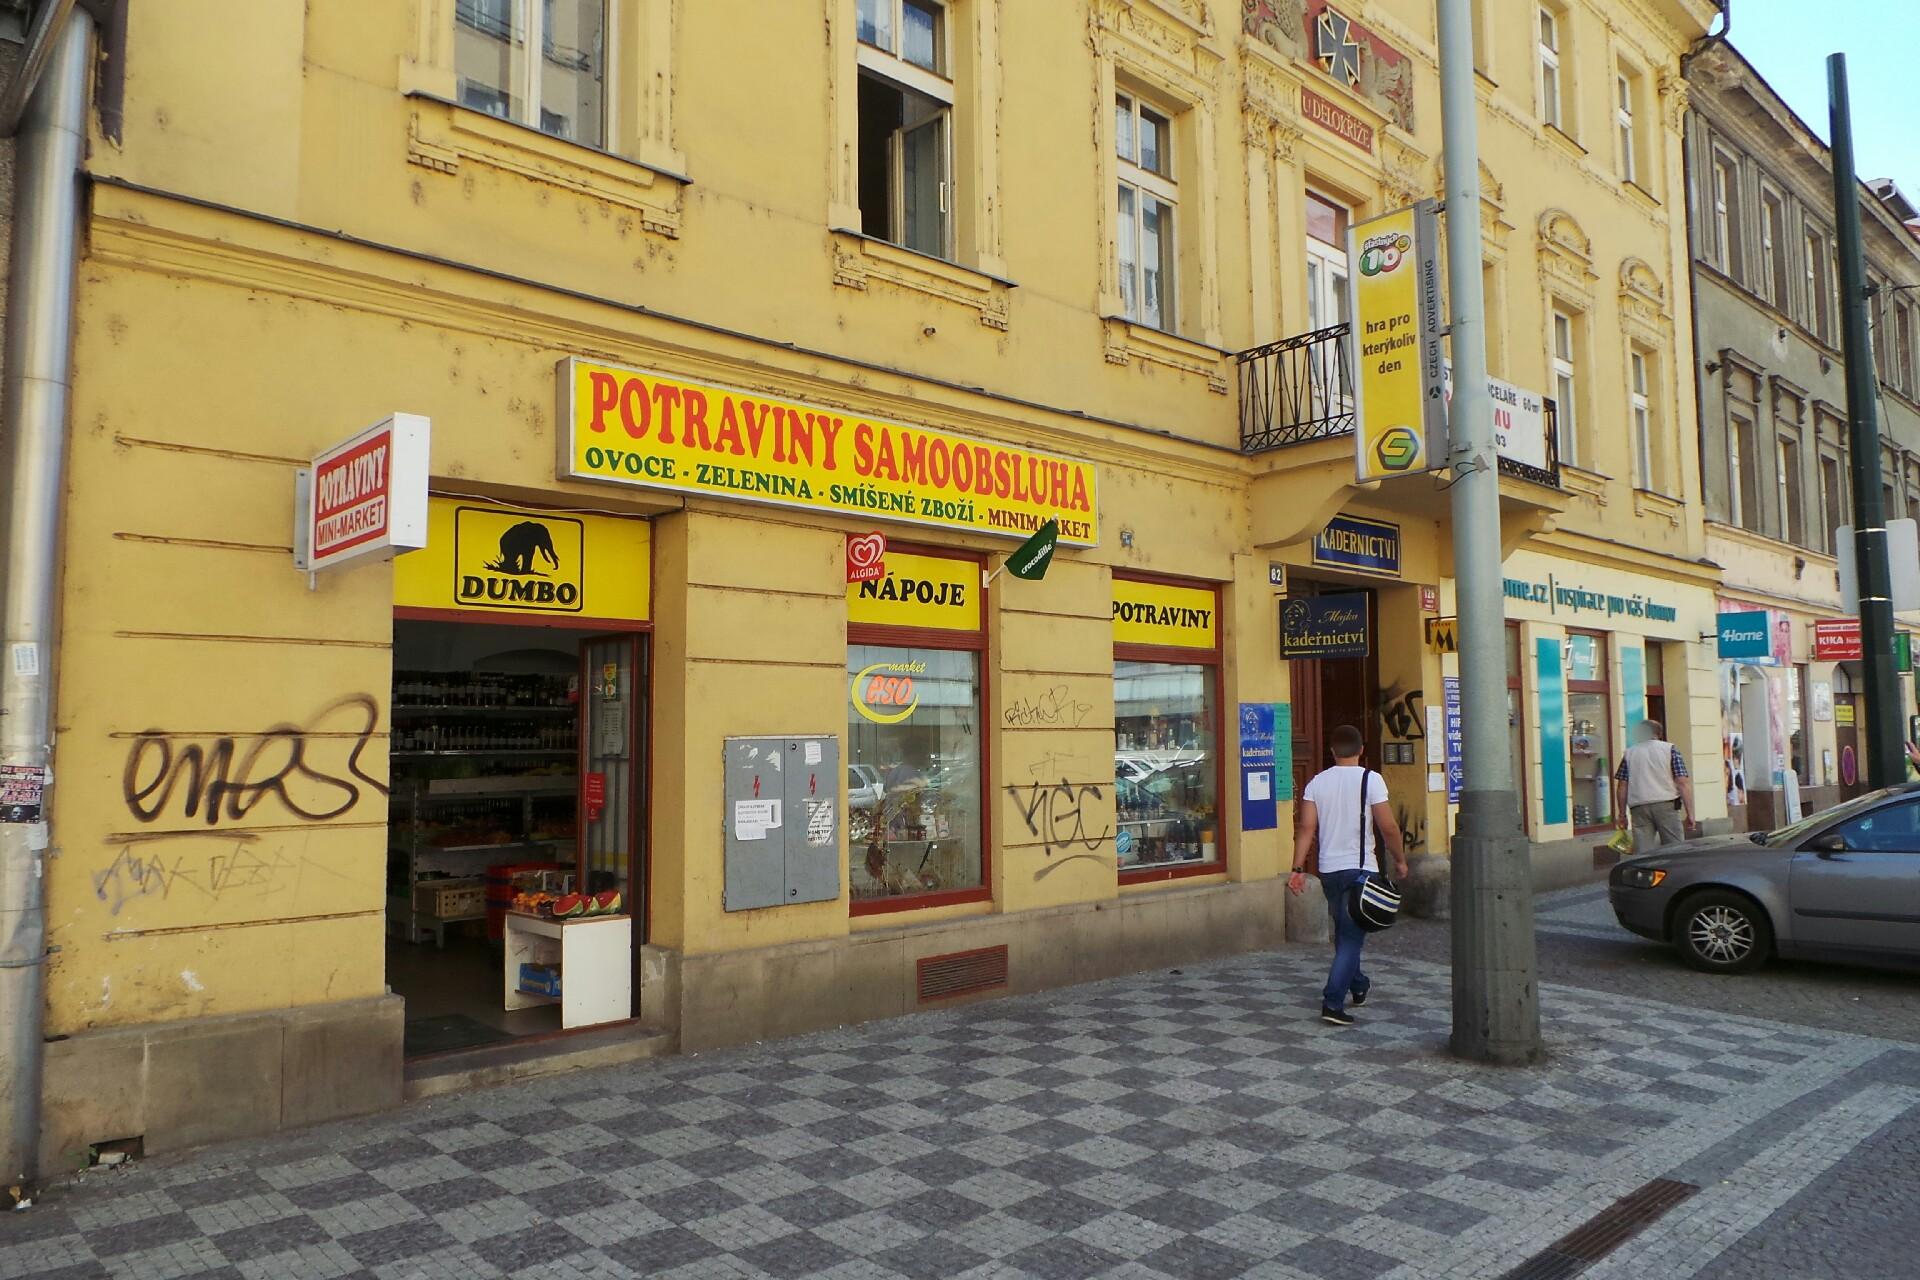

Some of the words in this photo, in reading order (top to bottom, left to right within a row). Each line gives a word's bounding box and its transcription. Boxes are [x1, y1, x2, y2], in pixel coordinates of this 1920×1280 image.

[1425, 259, 1436, 333] ADVERTISING
[1366, 319, 1386, 334] hra
[1389, 313, 1410, 332] pro
[1362, 333, 1416, 358] kterýkoliv
[1429, 341, 1439, 378] CZECH
[1378, 359, 1402, 375] den
[589, 371, 843, 471] POTRAVINY
[853, 423, 1091, 513] SAMOOBSLUHA
[319, 445, 386, 514] POTRAVINY
[585, 447, 676, 479] OVOCE
[696, 463, 813, 499] ZELENINA
[830, 482, 915, 514] SMÍŠENÉ
[921, 498, 975, 523] ZBOŽÍ
[317, 500, 384, 546] MINI-MARKET
[1020, 543, 1053, 575] crocodille
[1320, 528, 1397, 561] KADEŘNICTVÍ
[850, 566, 881, 580] ALGIDA
[460, 575, 578, 605] DUMBO
[858, 572, 965, 607] NÁPOJE
[1555, 581, 1606, 614] inspirace
[1607, 595, 1624, 618] pro
[1625, 593, 1644, 618] váš
[1644, 597, 1676, 623] domov
[1112, 600, 1211, 629] POTRAVINY
[1283, 627, 1365, 647] kadeřnictví
[1721, 629, 1764, 643] 4Home
[1818, 635, 1844, 646] KIKA
[887, 659, 926, 674] market
[866, 675, 913, 705] eso
